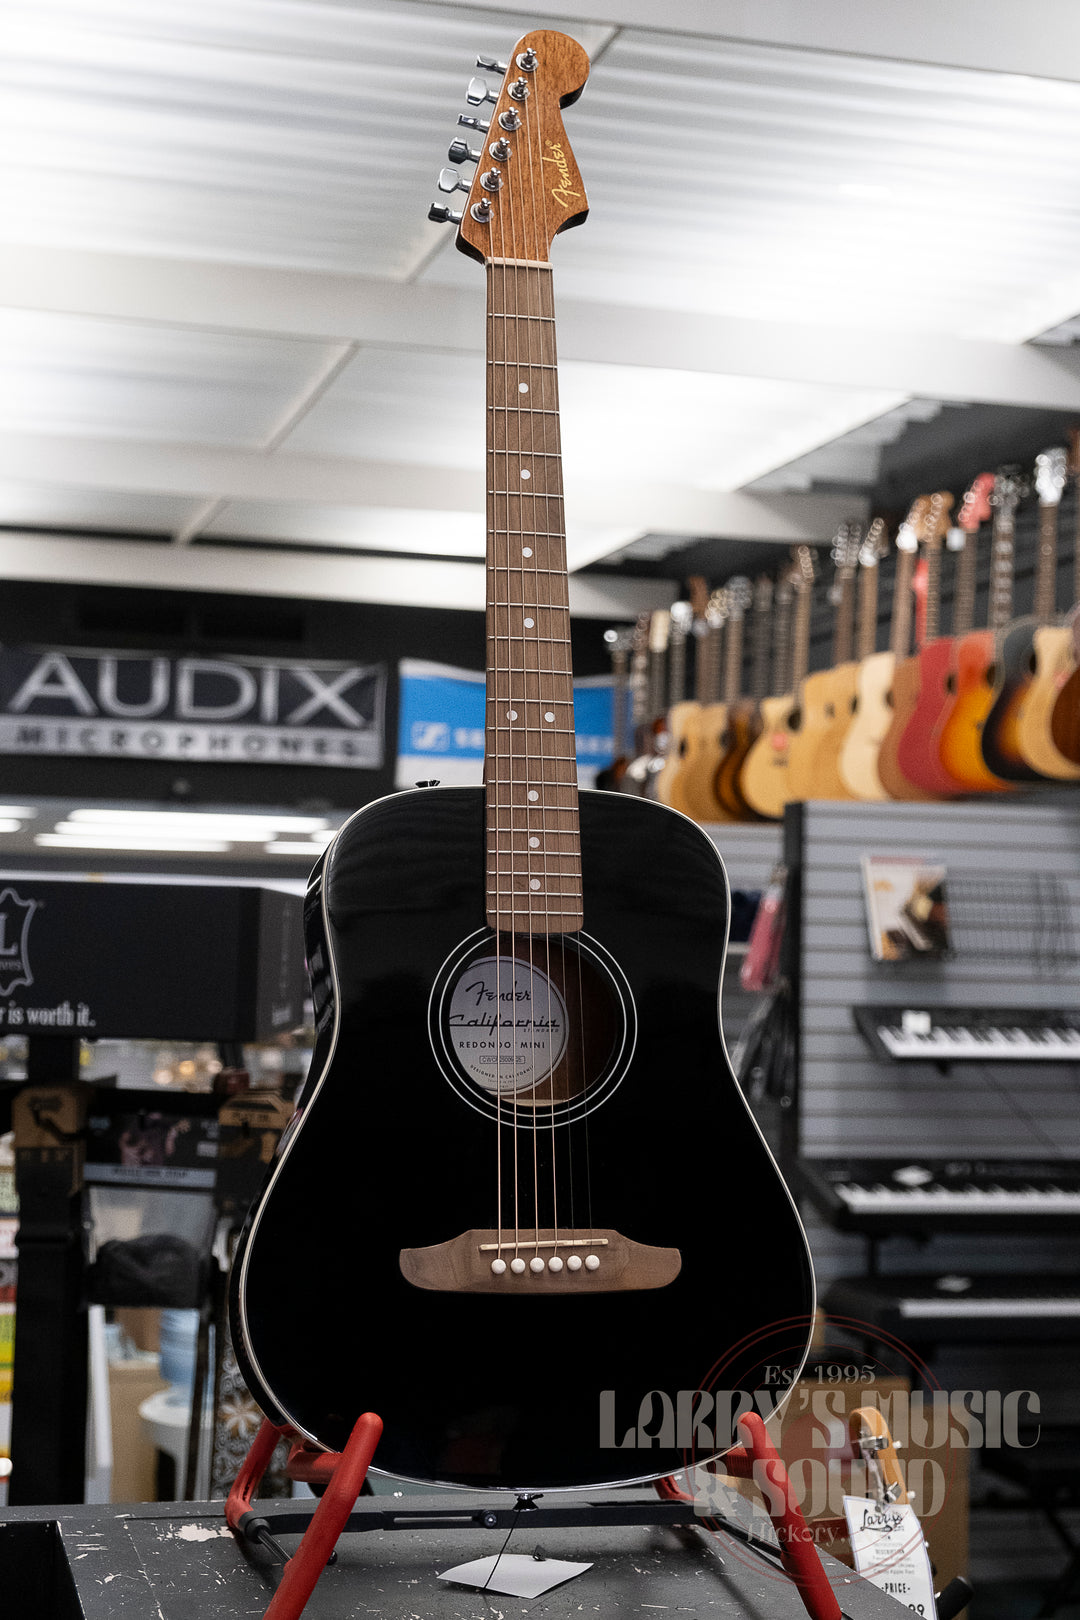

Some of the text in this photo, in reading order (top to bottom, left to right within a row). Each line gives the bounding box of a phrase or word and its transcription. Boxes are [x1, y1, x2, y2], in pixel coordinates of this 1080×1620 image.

[542, 142, 581, 208] Fender
[6, 651, 368, 728] AUDIX
[15, 726, 358, 757] MICROPHONES
[464, 981, 532, 1006] Fender
[7, 1000, 24, 1025] is
[26, 1001, 75, 1027] worth
[76, 1002, 97, 1028] it.
[449, 1012, 560, 1036] California
[459, 1041, 545, 1049] REDONDO MINI
[505, 1064, 535, 1079] CALFORNIA
